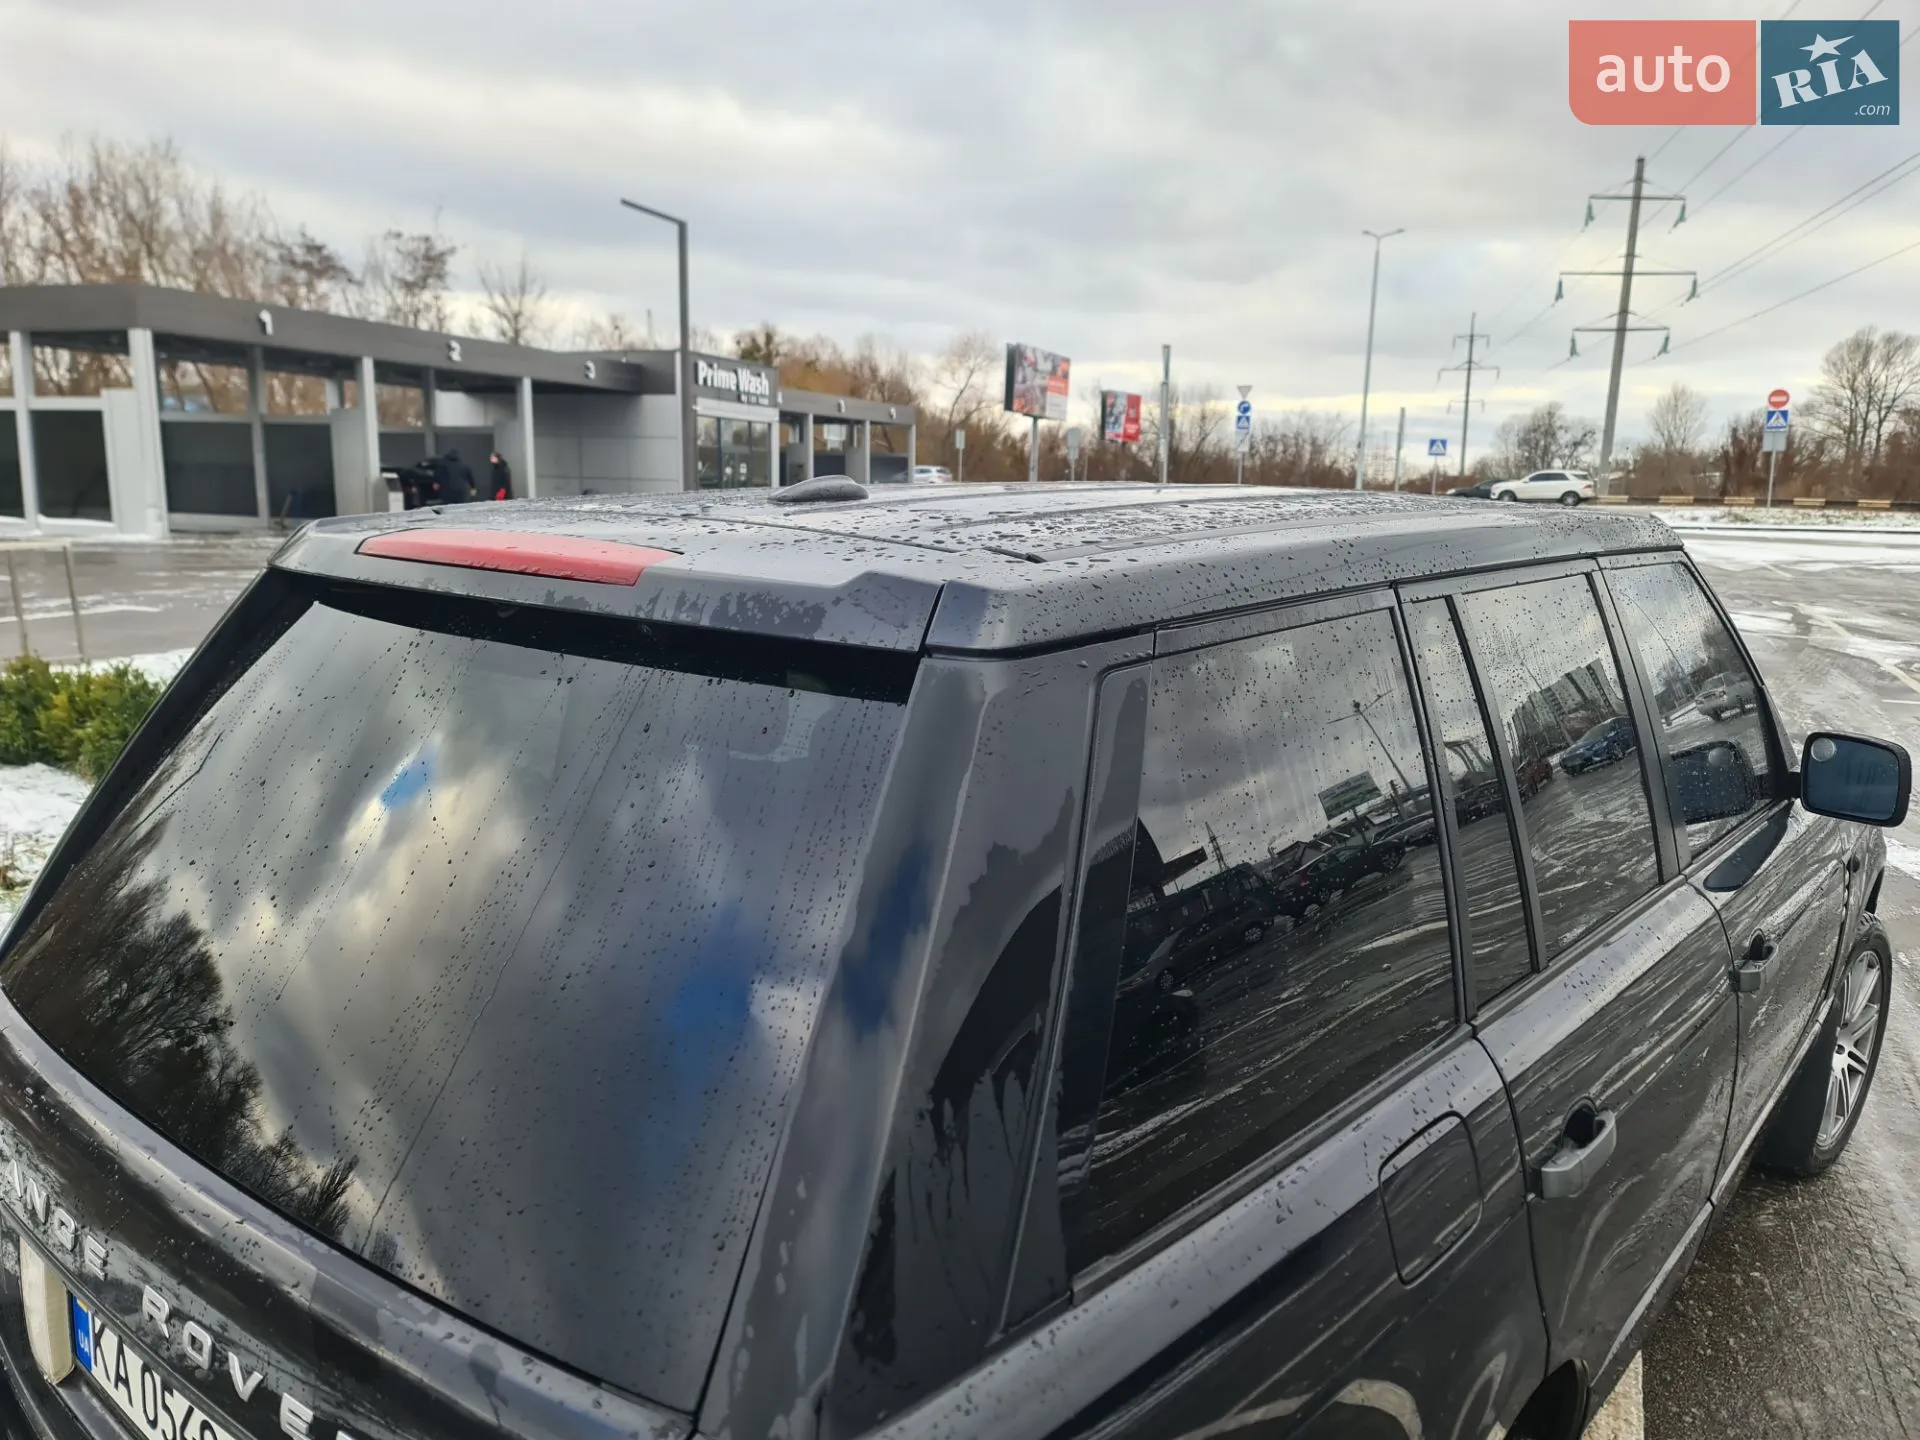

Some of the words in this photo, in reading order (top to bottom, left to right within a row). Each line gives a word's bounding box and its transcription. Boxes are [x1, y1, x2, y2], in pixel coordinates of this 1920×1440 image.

[259, 309, 273, 336] 1
[697, 360, 737, 391] Prime
[737, 367, 770, 396] Wash
[141, 1284, 357, 1440] ROVE
